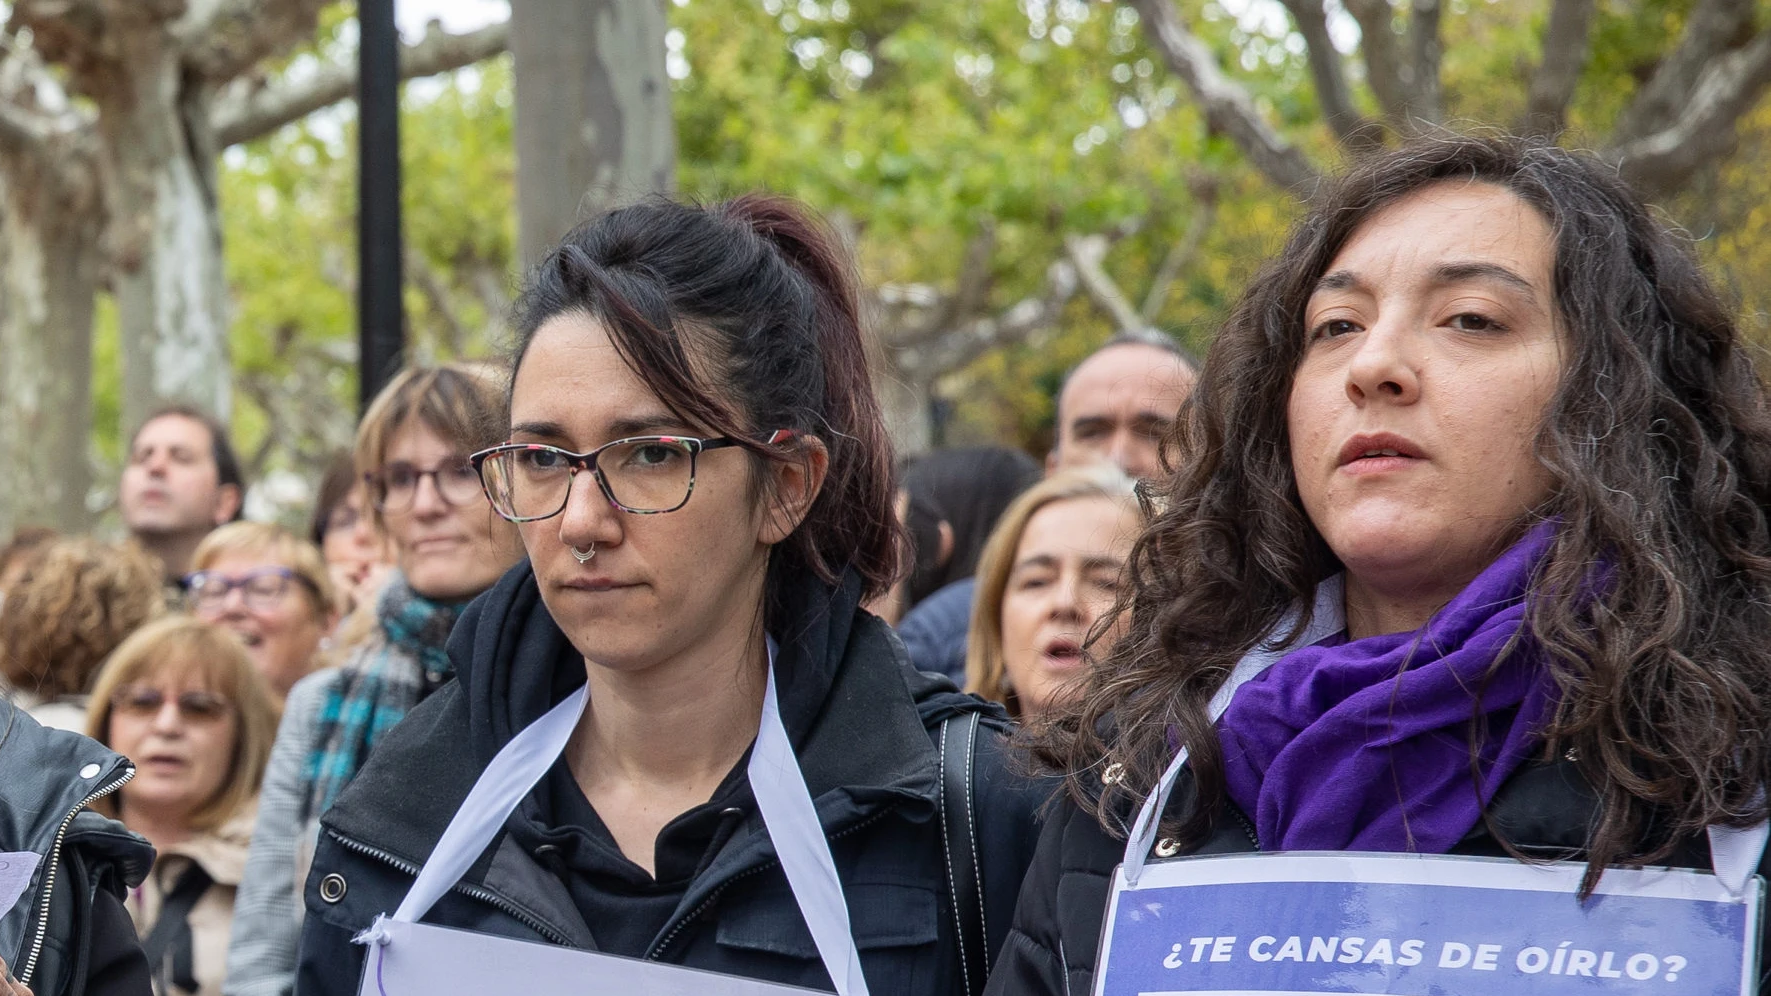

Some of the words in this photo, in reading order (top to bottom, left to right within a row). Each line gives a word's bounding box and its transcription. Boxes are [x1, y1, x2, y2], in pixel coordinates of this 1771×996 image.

[1162, 936, 1236, 970] ¿TE
[1248, 935, 1426, 967] CANSAS
[1438, 941, 1503, 972] DE
[1515, 940, 1688, 983] OÍRLO?
